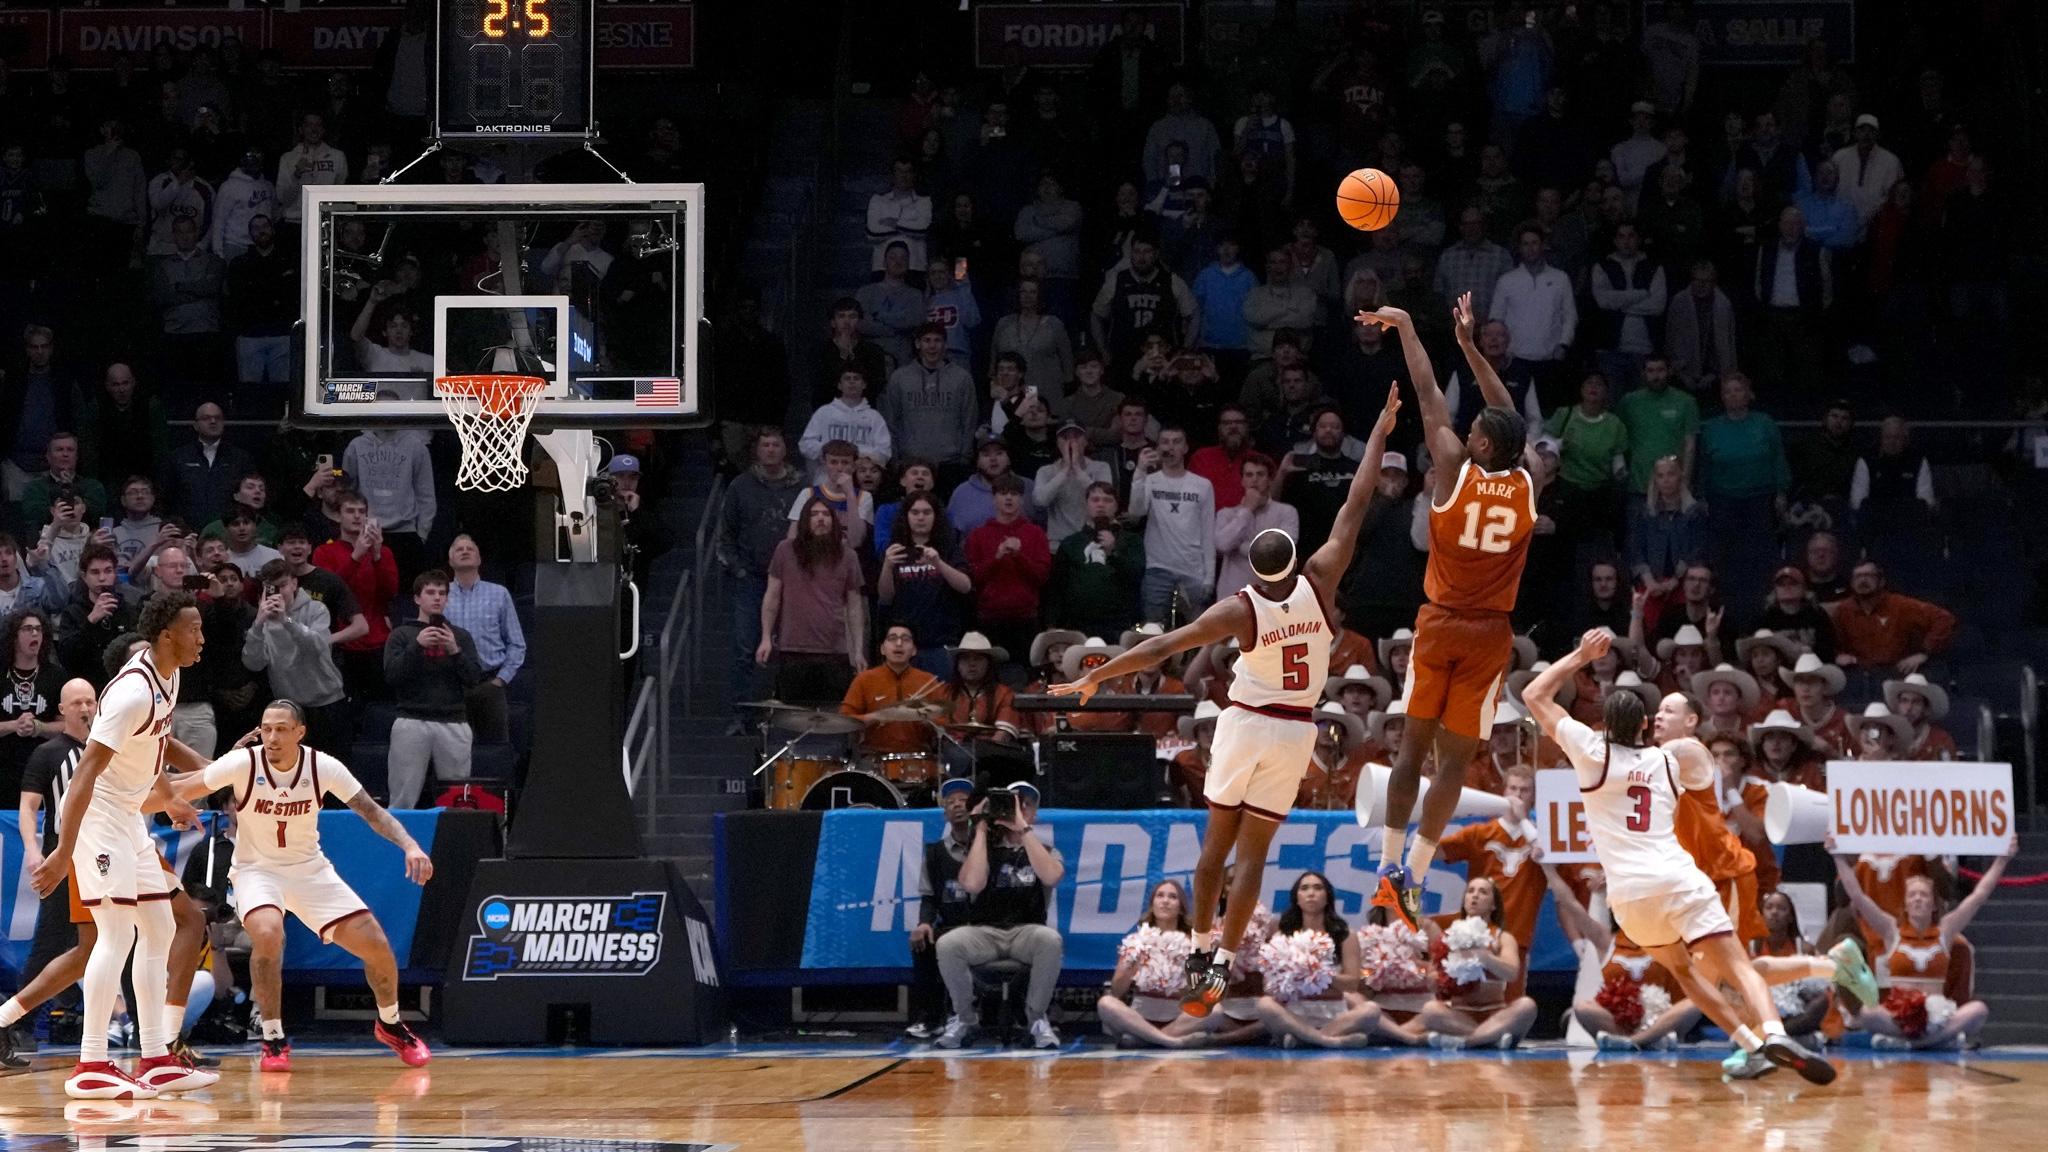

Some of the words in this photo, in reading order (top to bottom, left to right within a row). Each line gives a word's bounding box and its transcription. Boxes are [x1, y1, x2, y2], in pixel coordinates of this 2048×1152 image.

[313, 26, 390, 49] DAYT
[334, 383, 363, 392] MARCH
[337, 392, 376, 401] MADNESS
[1476, 482, 1516, 499] MARK
[1458, 501, 1518, 553] 12
[1261, 621, 1322, 647] HOLLOMAN
[1282, 642, 1310, 691] 5
[726, 779, 747, 794] 101
[1627, 770, 1654, 784] ABLE
[254, 798, 274, 815] NC
[273, 799, 313, 817] STATE
[1626, 785, 1652, 833] 3
[1834, 787, 2008, 837] LONGHORNS
[276, 820, 288, 848] 1
[1549, 801, 1588, 852] LE
[872, 820, 1465, 934] MDNESS
[511, 903, 612, 932] MARCH
[522, 933, 658, 962] MADNESS
